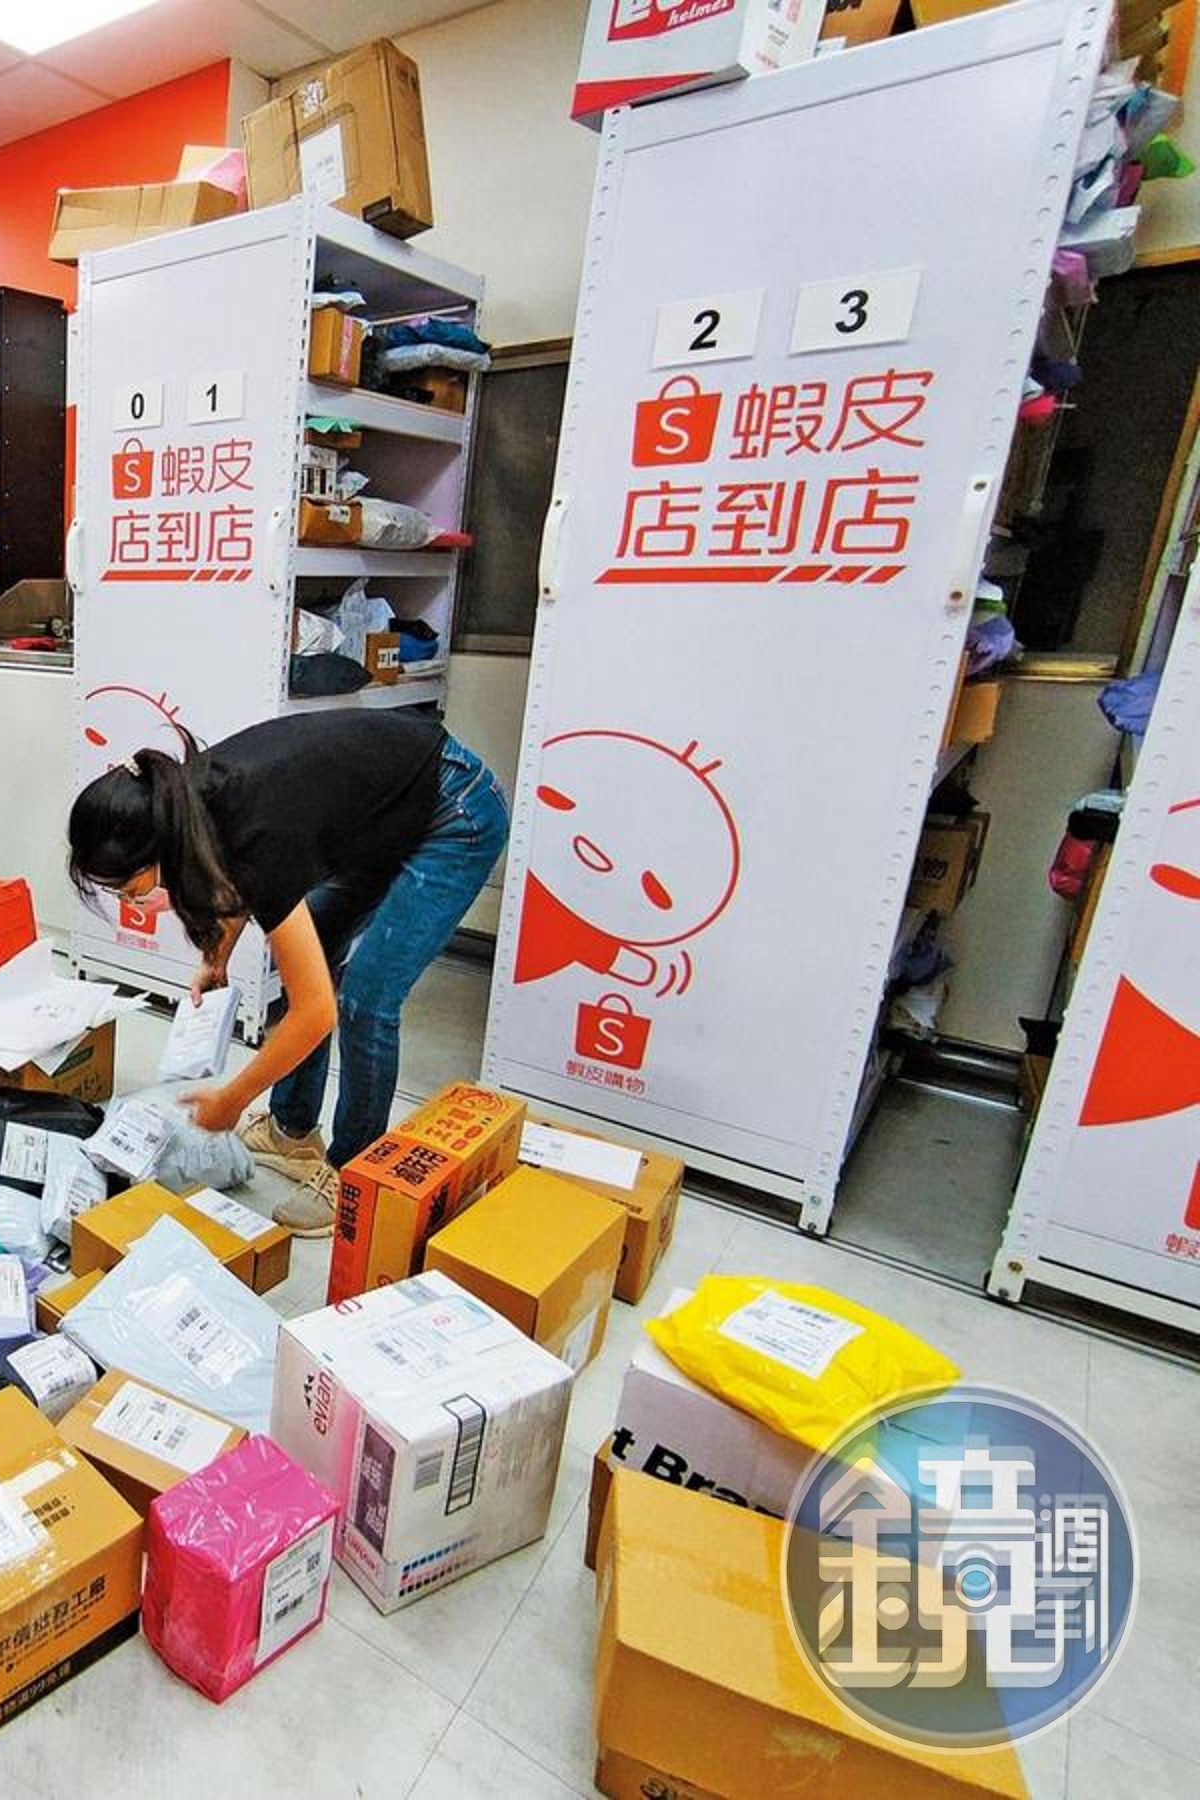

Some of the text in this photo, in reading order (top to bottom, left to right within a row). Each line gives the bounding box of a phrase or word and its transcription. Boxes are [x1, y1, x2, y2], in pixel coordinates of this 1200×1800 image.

[689, 289, 869, 350] 2 3
[131, 383, 218, 420] 0 1
[731, 369, 934, 460] 蝦皮
[161, 438, 254, 497] 蝦皮
[110, 503, 254, 563] 店到店
[615, 467, 920, 559] 店到店
[313, 1369, 334, 1436] evian
